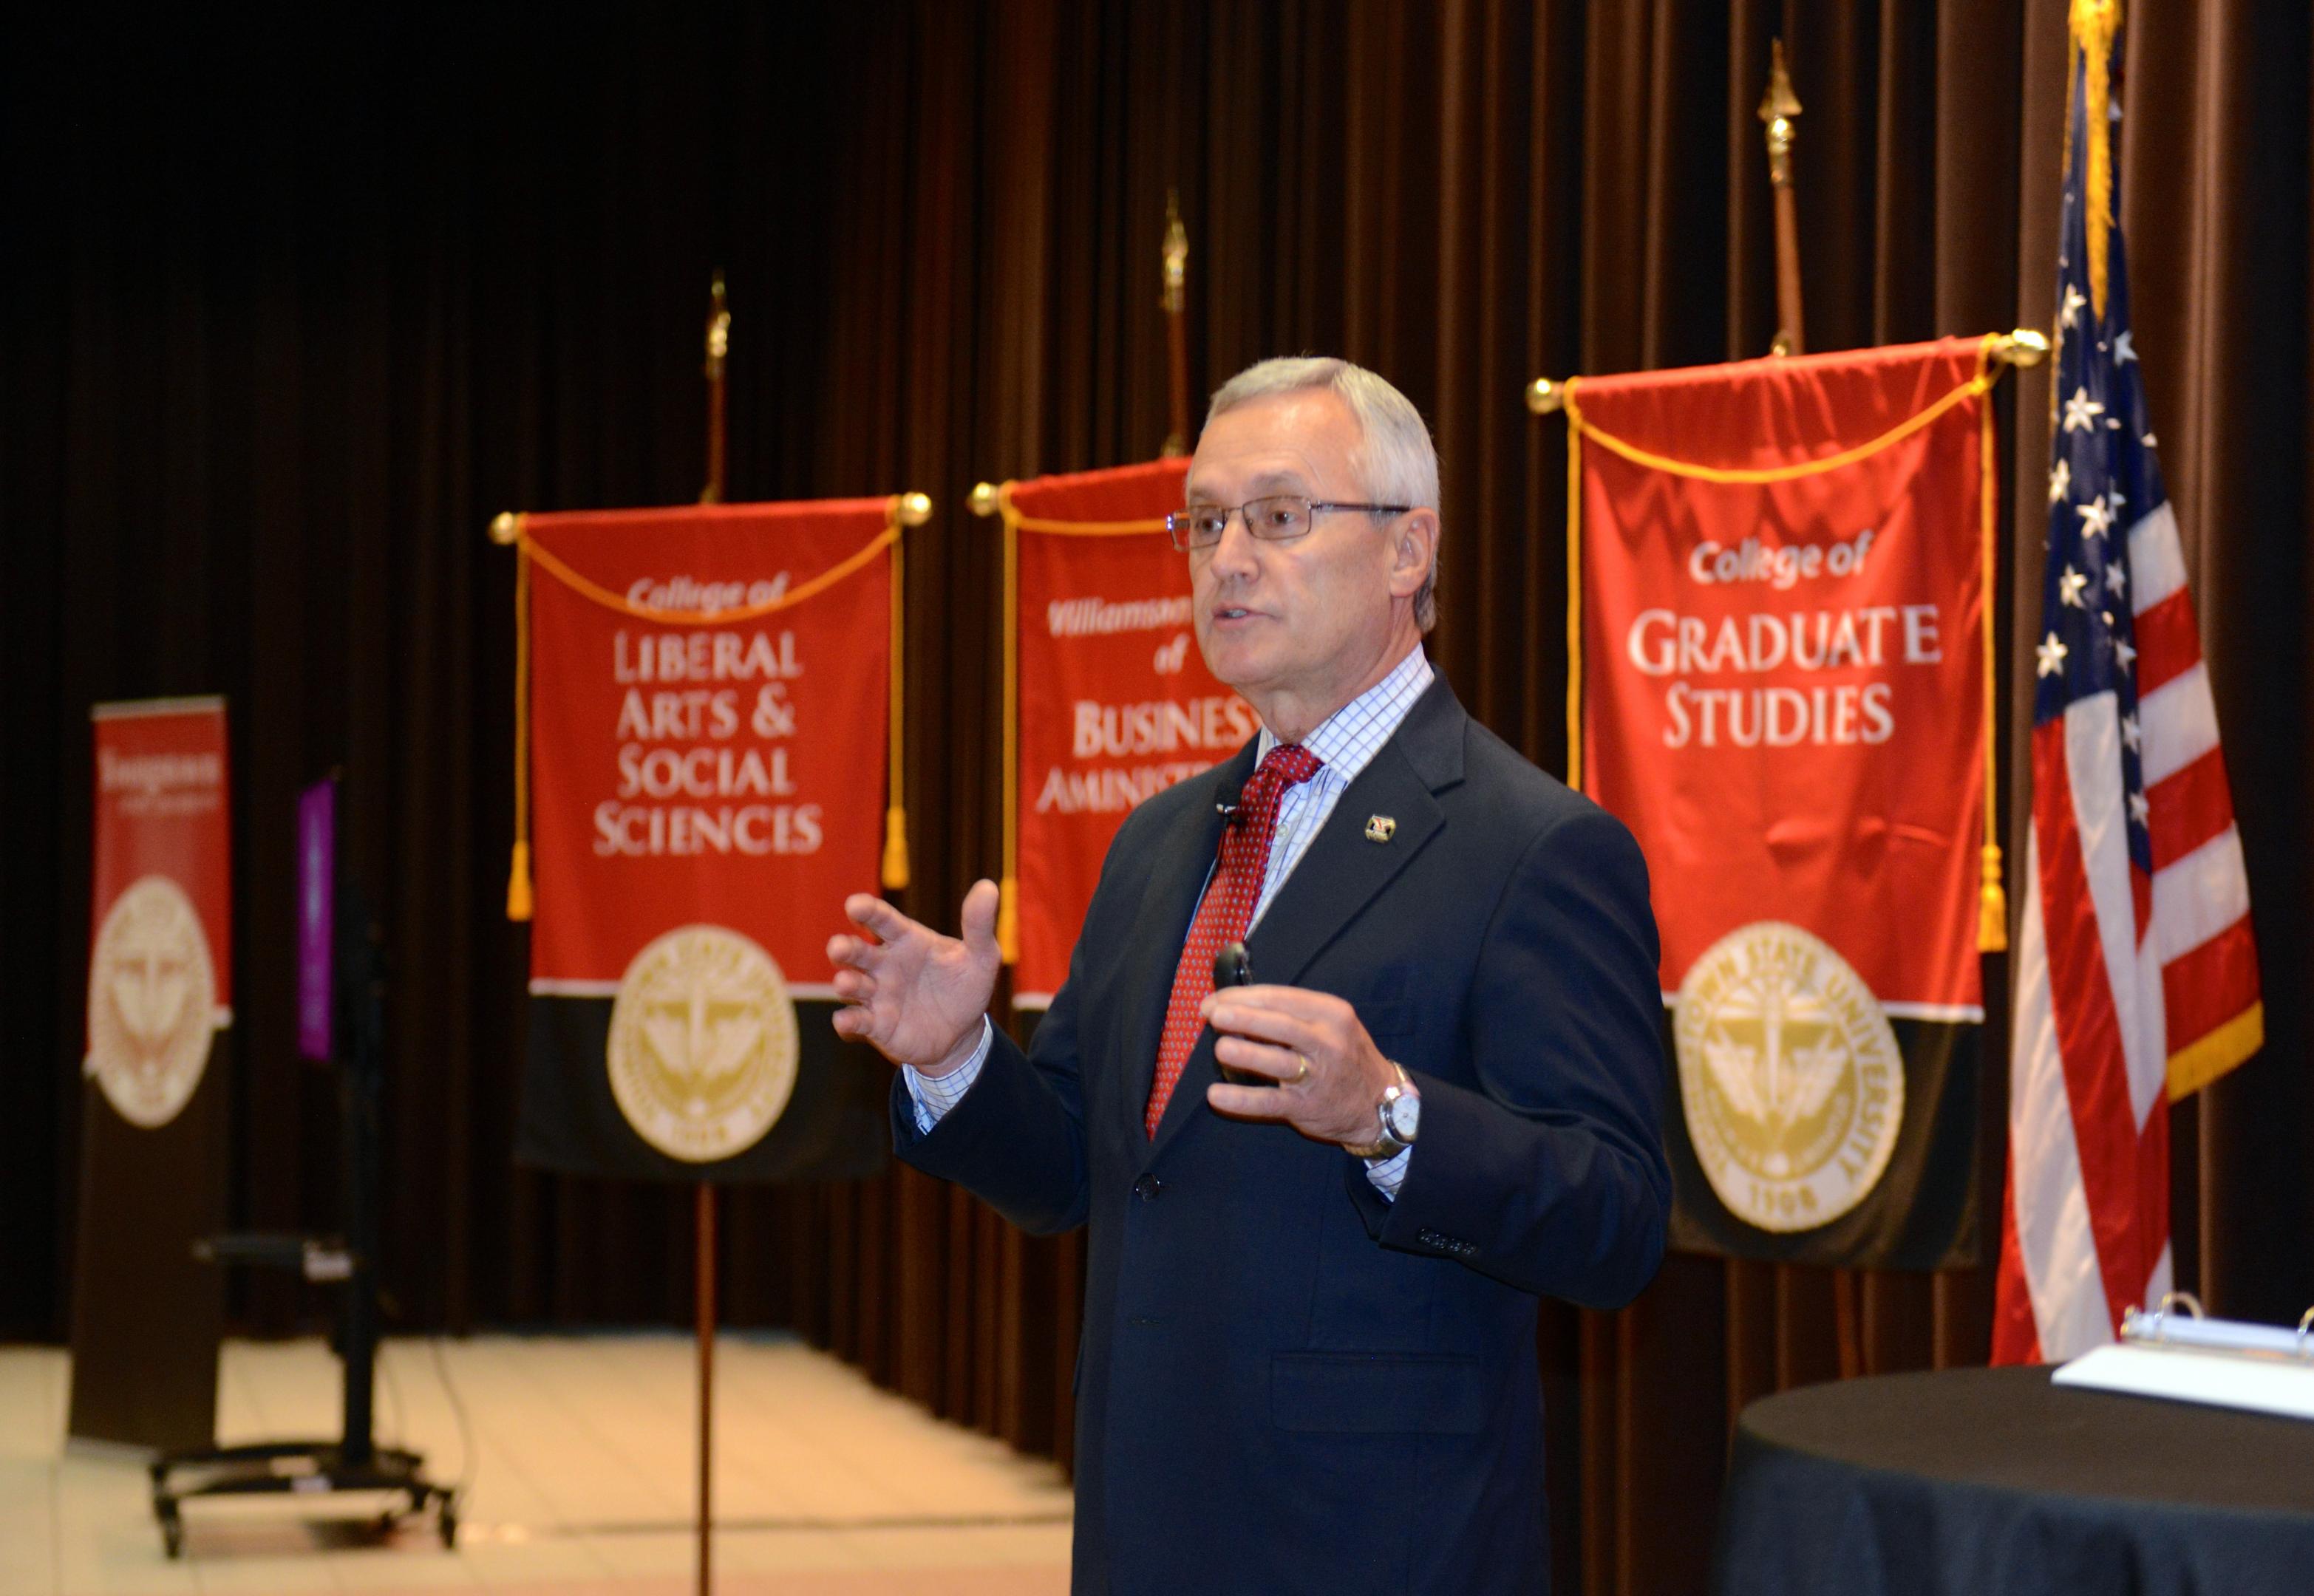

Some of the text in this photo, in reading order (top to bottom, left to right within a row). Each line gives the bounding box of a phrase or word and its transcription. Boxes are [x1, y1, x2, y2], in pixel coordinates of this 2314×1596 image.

[1690, 530, 1875, 589] College of
[627, 576, 745, 618] College
[613, 630, 802, 683] LIBERAL
[1154, 632, 1190, 675] of
[1627, 603, 1943, 675] GRADUATE
[616, 681, 795, 740] ARTS &
[1073, 696, 1262, 759] BUSINES
[1663, 681, 1895, 748] STUDIES
[617, 743, 795, 799] SOCIAL
[593, 800, 823, 857] SCIENCES
